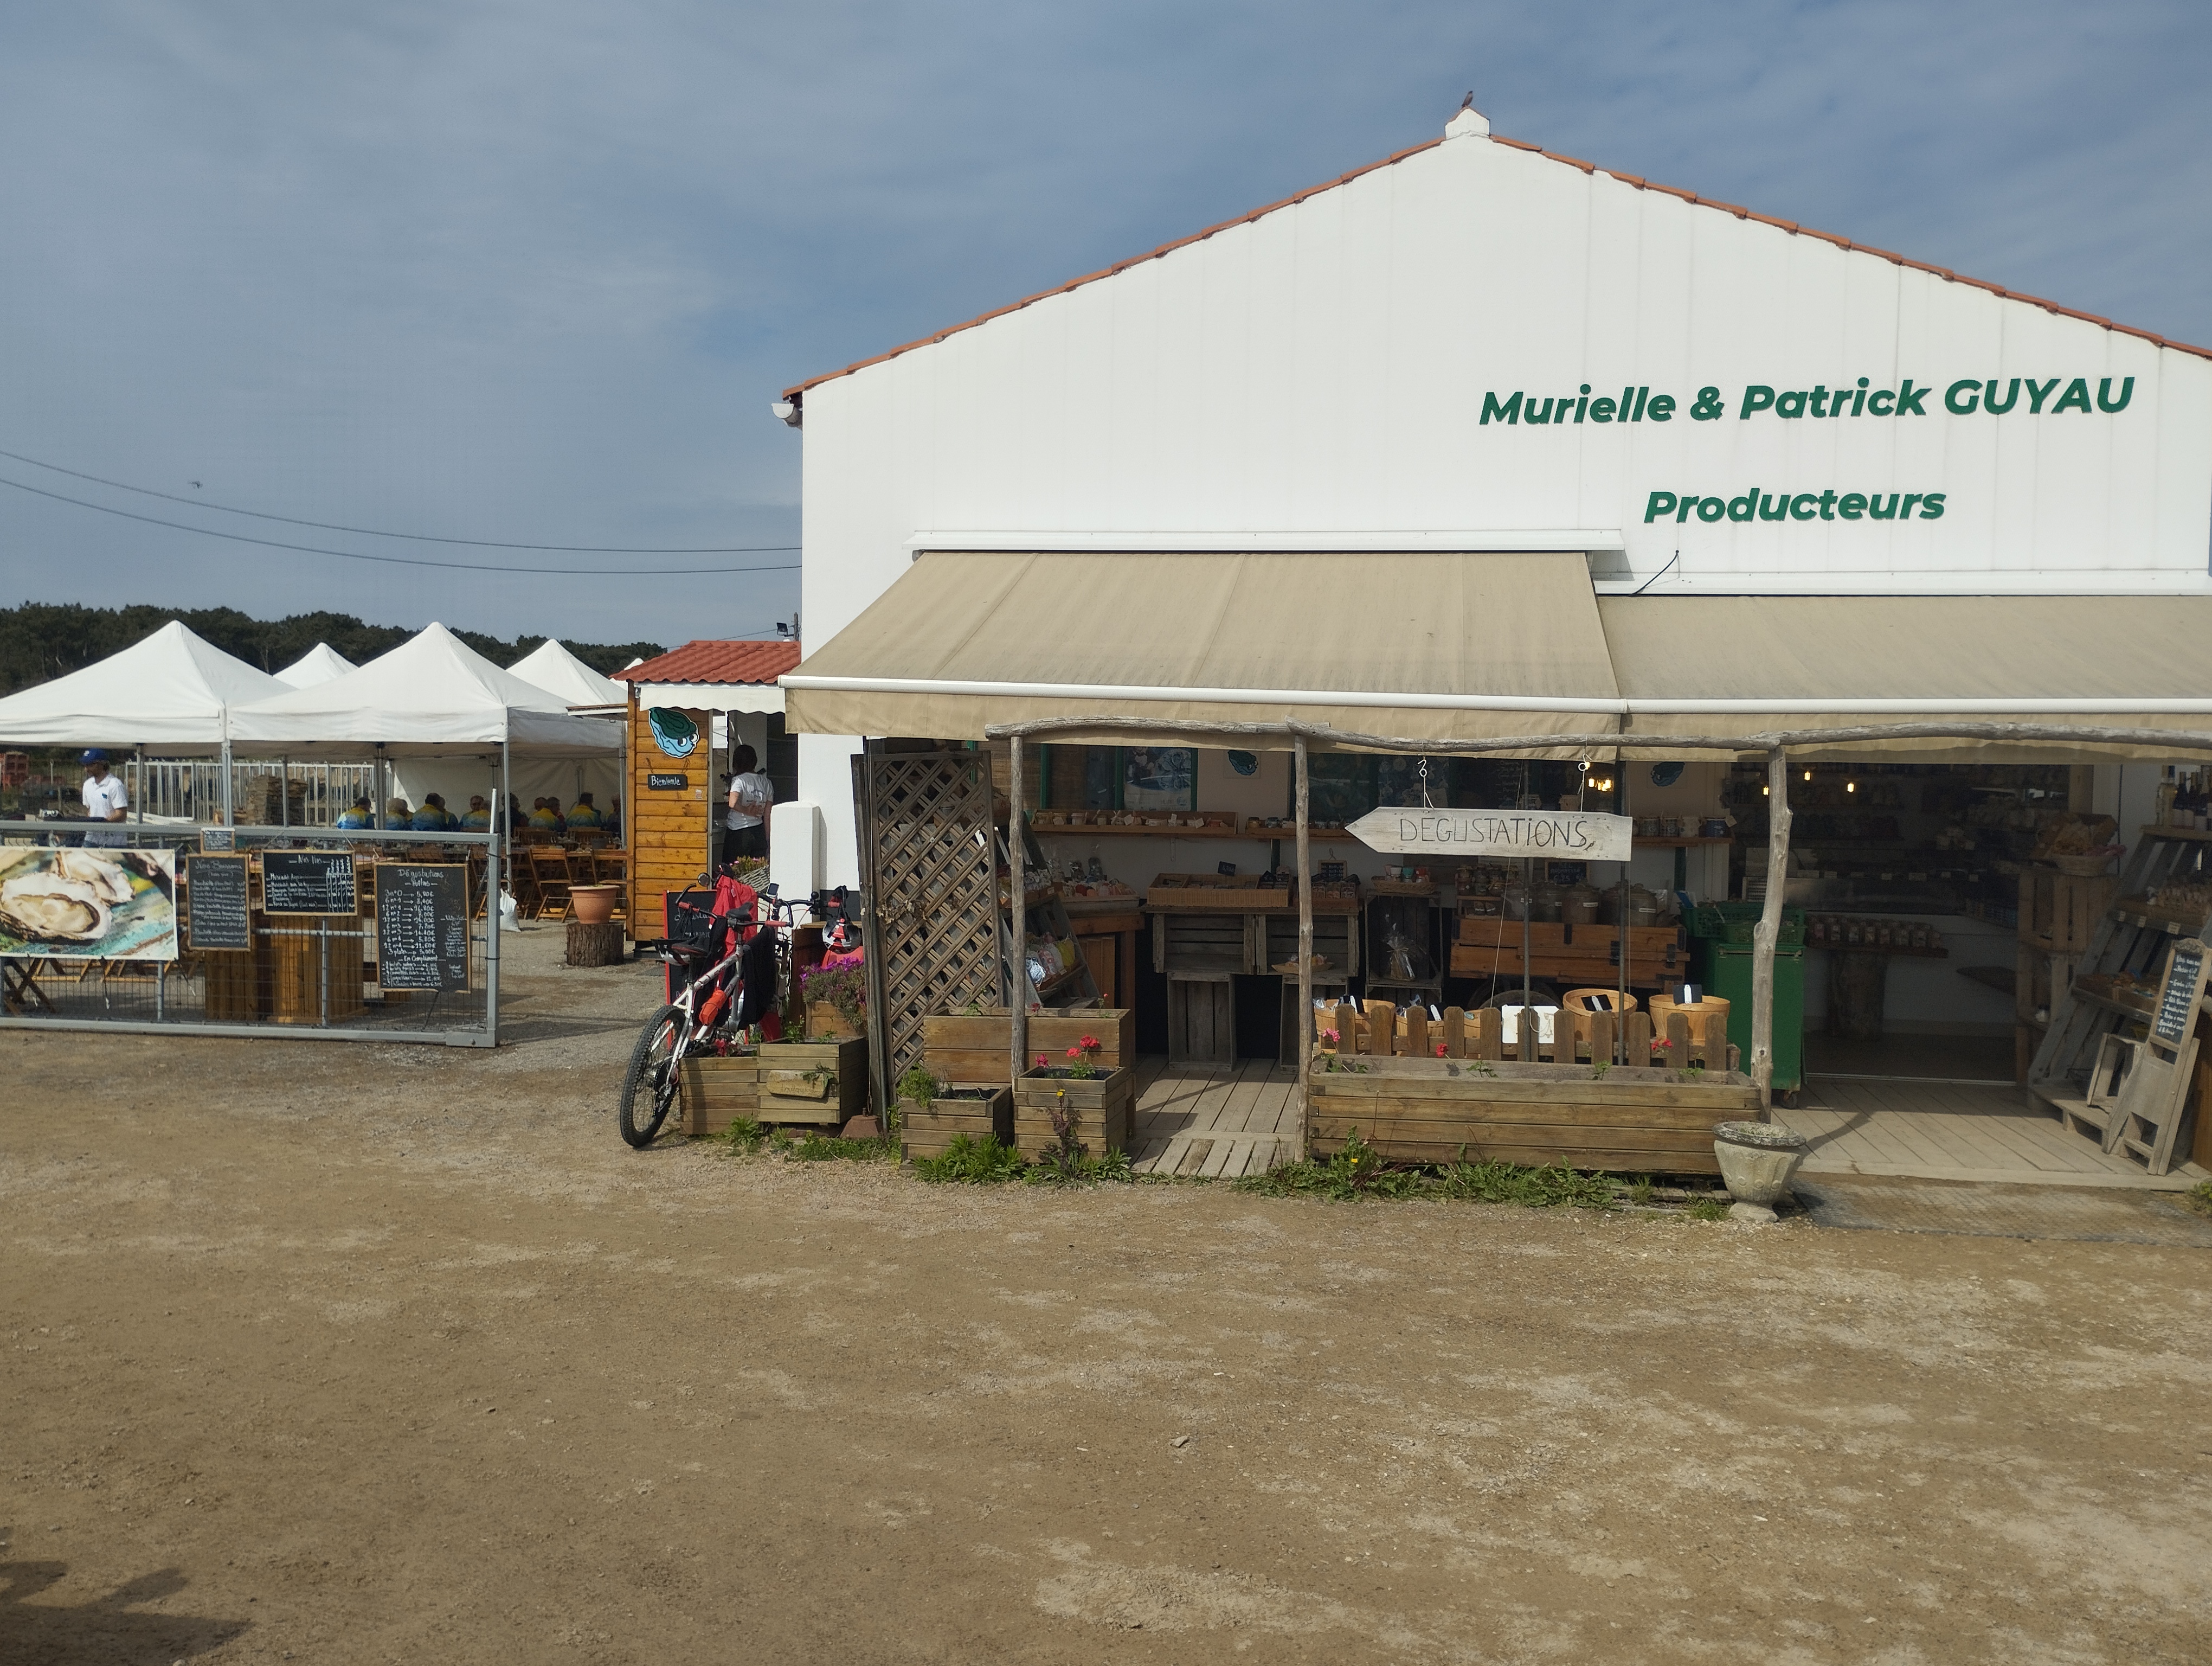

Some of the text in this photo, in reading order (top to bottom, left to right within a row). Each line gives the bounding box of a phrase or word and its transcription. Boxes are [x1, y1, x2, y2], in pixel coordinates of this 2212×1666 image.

[1479, 376, 2135, 424] Murielle & Patrick GUYAU
[1644, 488, 1946, 522] Producteurs
